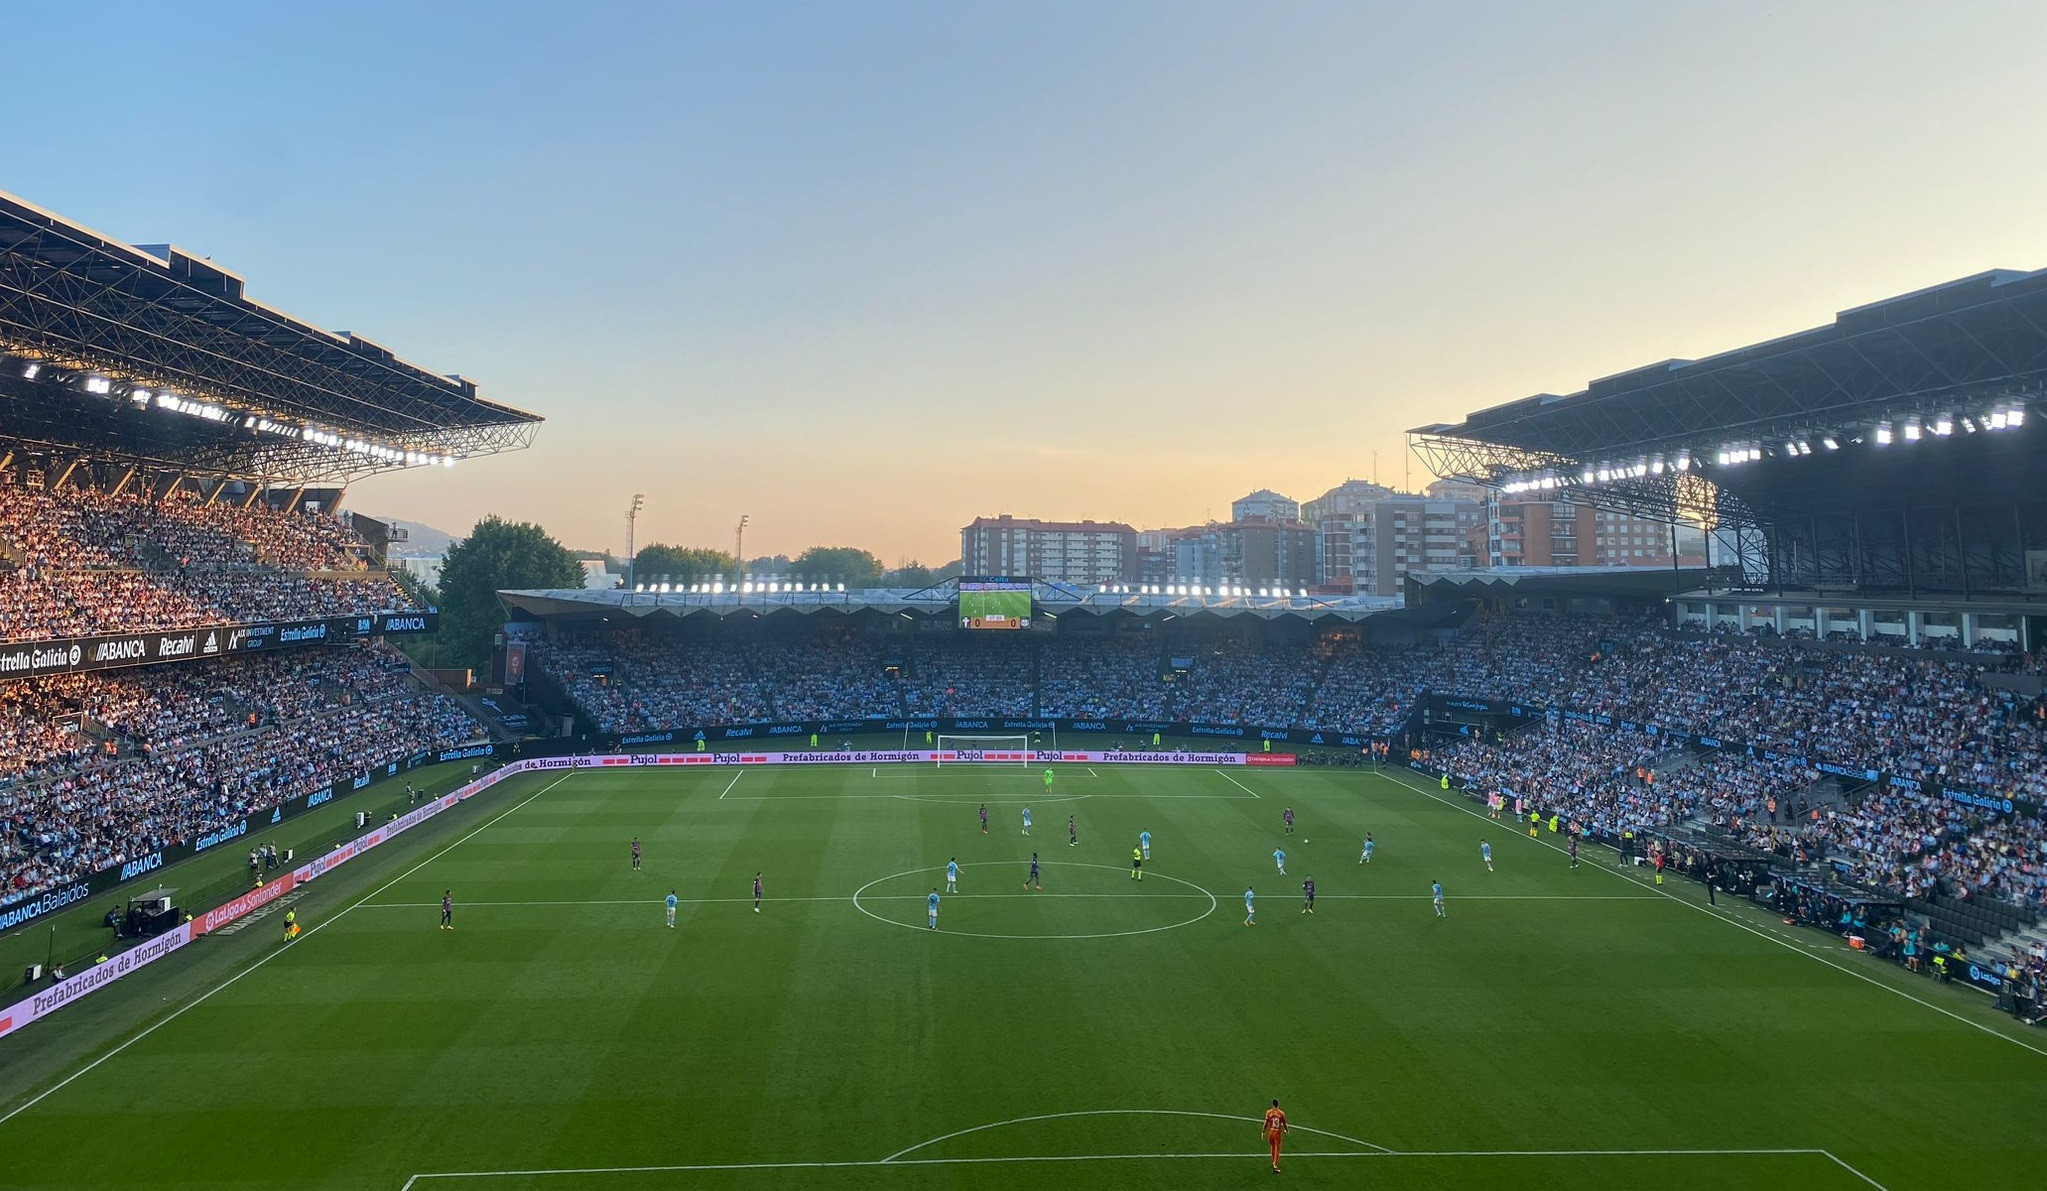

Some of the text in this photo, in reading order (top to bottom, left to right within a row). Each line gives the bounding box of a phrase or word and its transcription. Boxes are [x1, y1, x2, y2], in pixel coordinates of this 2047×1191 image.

[388, 618, 426, 631] ABANCA
[974, 619, 980, 627] 0
[1010, 619, 1016, 627] 0
[100, 640, 146, 661] ABANCA
[159, 635, 195, 656] Recalvi
[0, 648, 68, 672] trella Galicia
[771, 725, 802, 734] ABANCA
[1075, 722, 1106, 730] ABANCA
[725, 728, 752, 738] Recalvi
[1260, 730, 1288, 740] Recalvi
[630, 754, 657, 766] Pujol
[712, 753, 740, 765] Pujol
[783, 752, 919, 763] Prefabricados de Hormigón
[957, 750, 983, 761] Pujol
[1036, 750, 1063, 761] Pujol
[1103, 752, 1236, 764] Prefabricados de Hormigón
[524, 760, 538, 769] de
[1893, 777, 1922, 791] ABANCA
[309, 787, 333, 807] ABANCA
[1972, 793, 2002, 810] Galicia
[195, 824, 239, 852] Estrella Galicia
[123, 851, 163, 880] ABANCA
[310, 857, 326, 877] Pujol
[2, 882, 89, 930] ABANCA Balaídos
[214, 900, 239, 924] LaLiga
[246, 881, 282, 910] Santander
[33, 931, 182, 1016] Prefabricados de Hormigón
